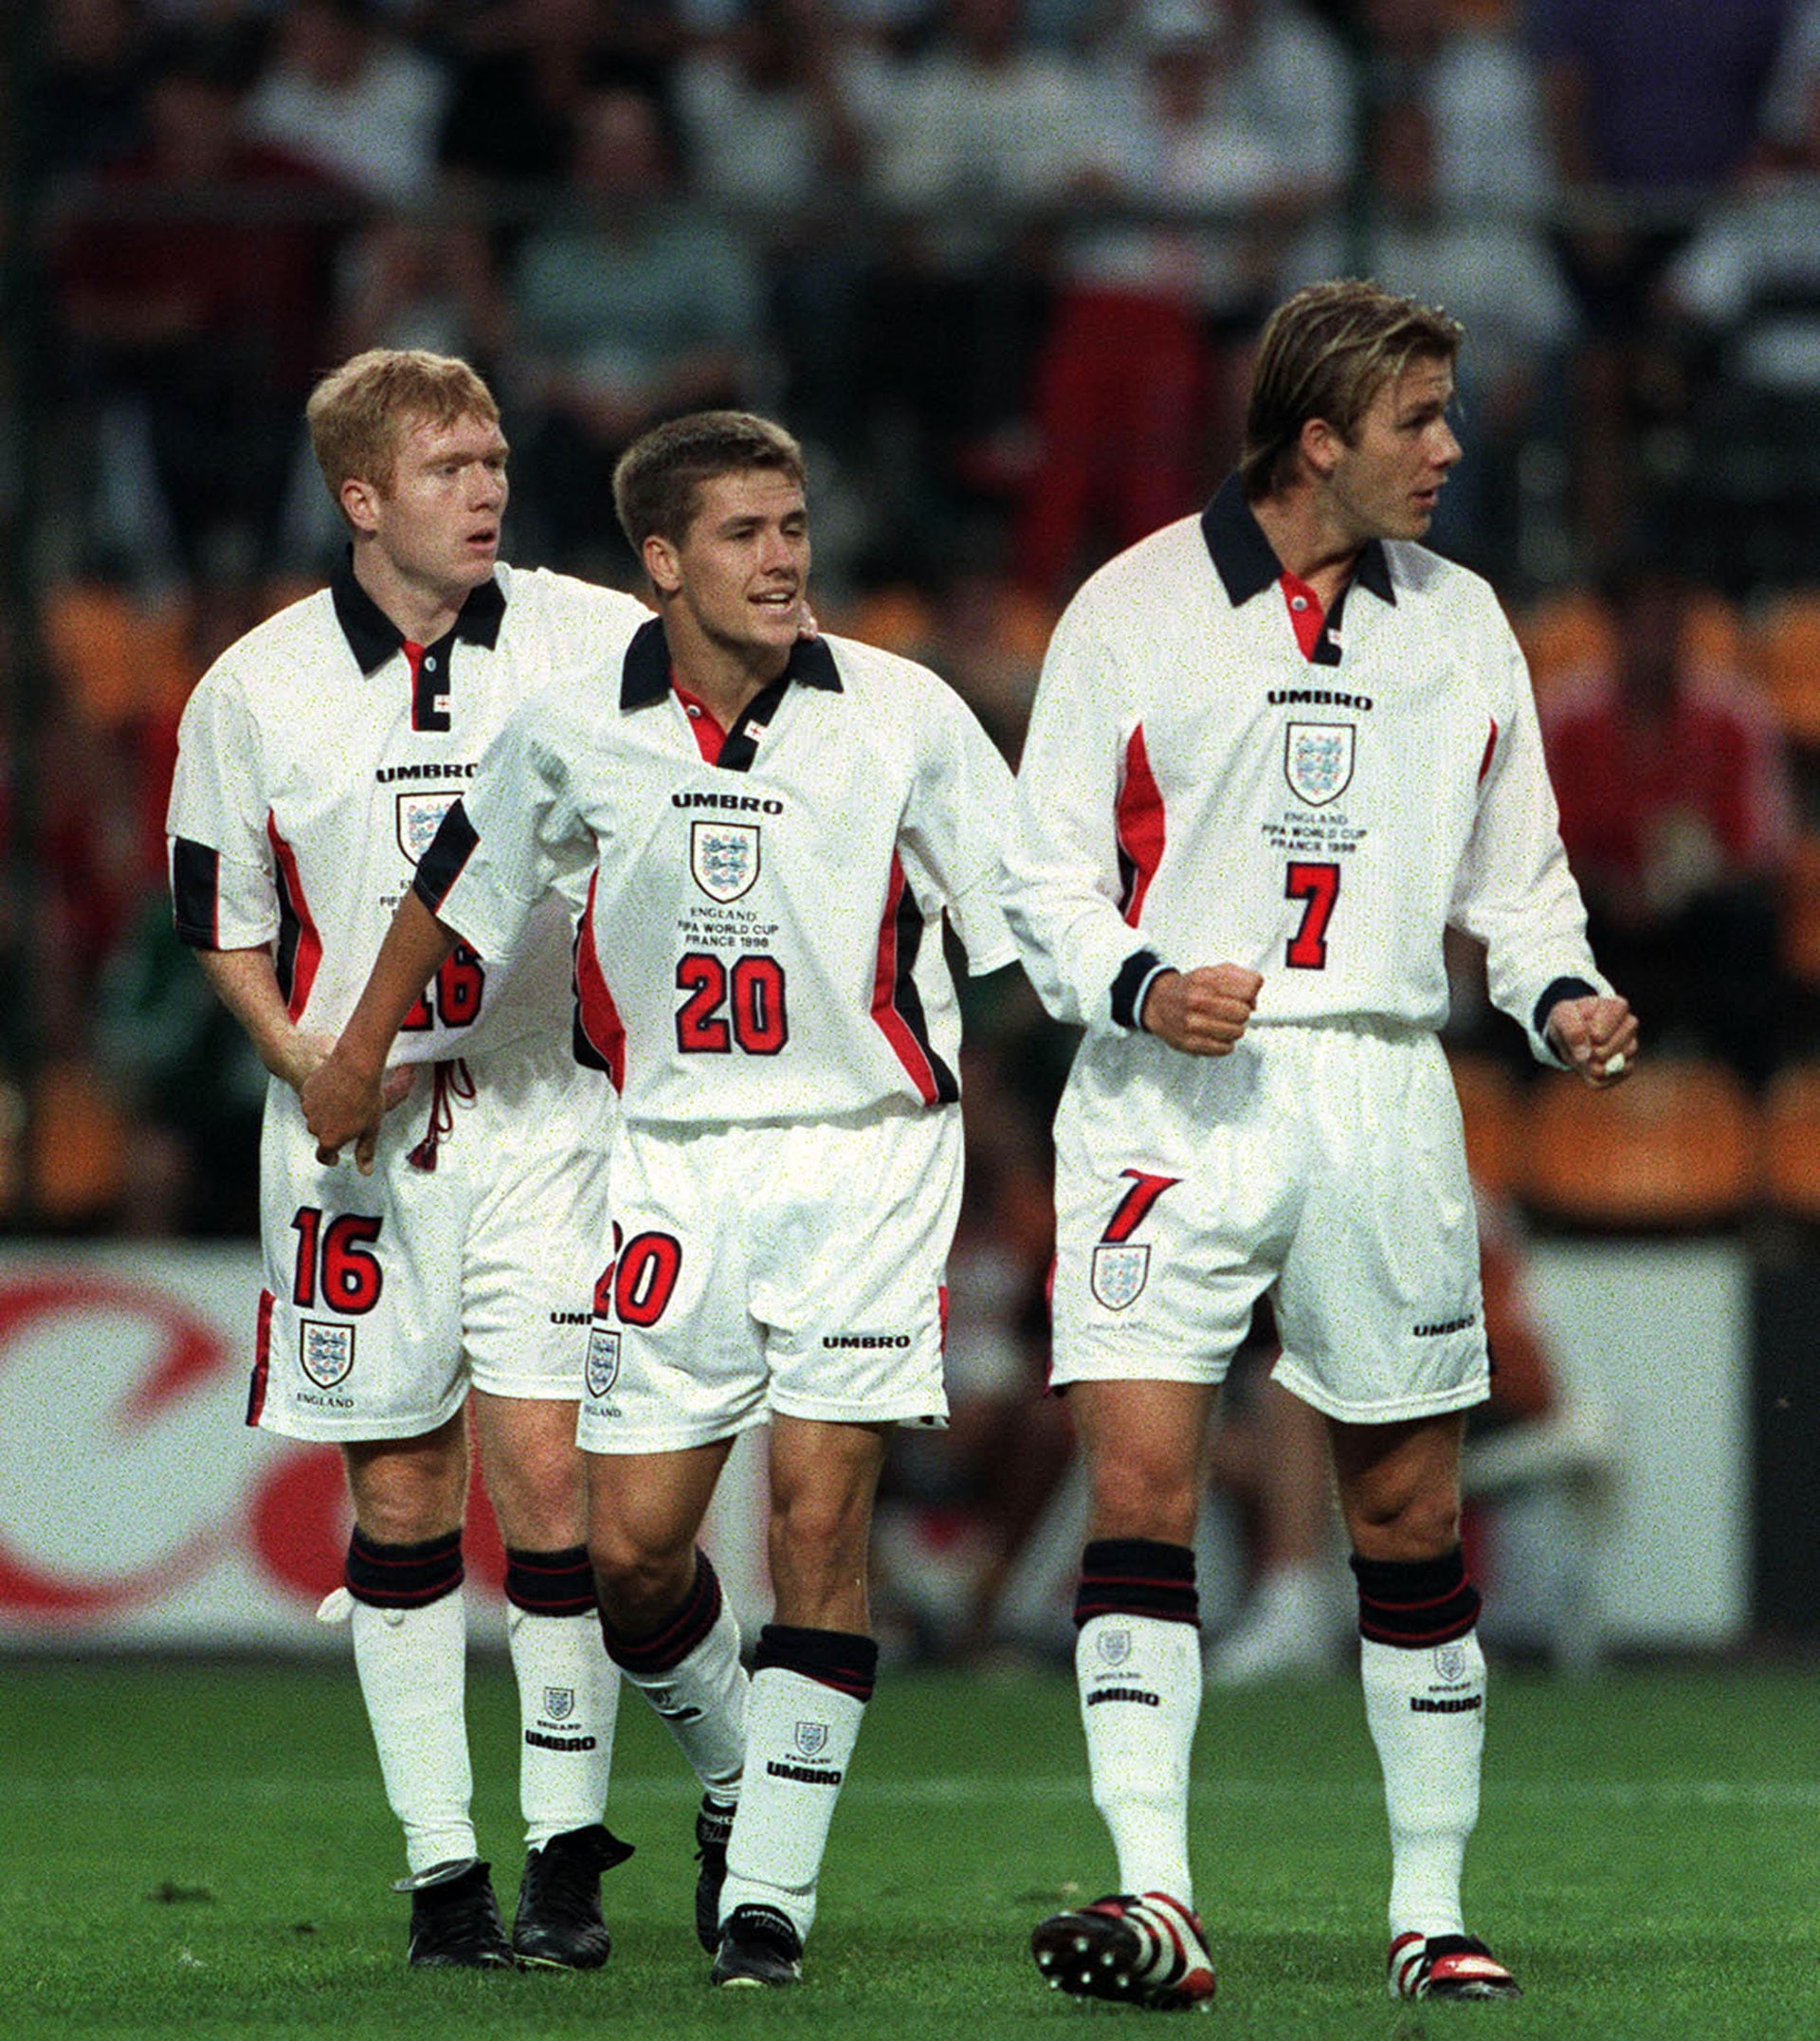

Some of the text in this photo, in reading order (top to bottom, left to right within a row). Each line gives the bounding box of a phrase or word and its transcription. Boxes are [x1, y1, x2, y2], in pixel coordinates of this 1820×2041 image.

[1267, 689, 1374, 711] UMBRO
[671, 793, 785, 815] UMBRO
[1292, 826, 1338, 839] WORLD
[1340, 828, 1368, 840] CUP
[1271, 837, 1322, 851] FRANCE
[690, 907, 757, 921] ENGLAND
[1284, 862, 1340, 971] 7
[678, 920, 779, 936] FIFA WORLD CUP
[685, 934, 769, 948] FRANCE 1998
[675, 952, 789, 1056] 20
[1100, 1168, 1184, 1244] 7
[290, 1206, 384, 1316] 16
[1413, 1313, 1475, 1338] UMBRO
[823, 1335, 911, 1348] UMBRO
[296, 1392, 355, 1409] ENGLAND
[1086, 1687, 1159, 1707] UMBRO
[1410, 1694, 1482, 1713] UMBRO
[526, 1729, 596, 1752] UMBRO
[767, 1760, 842, 1785] UMBRO
